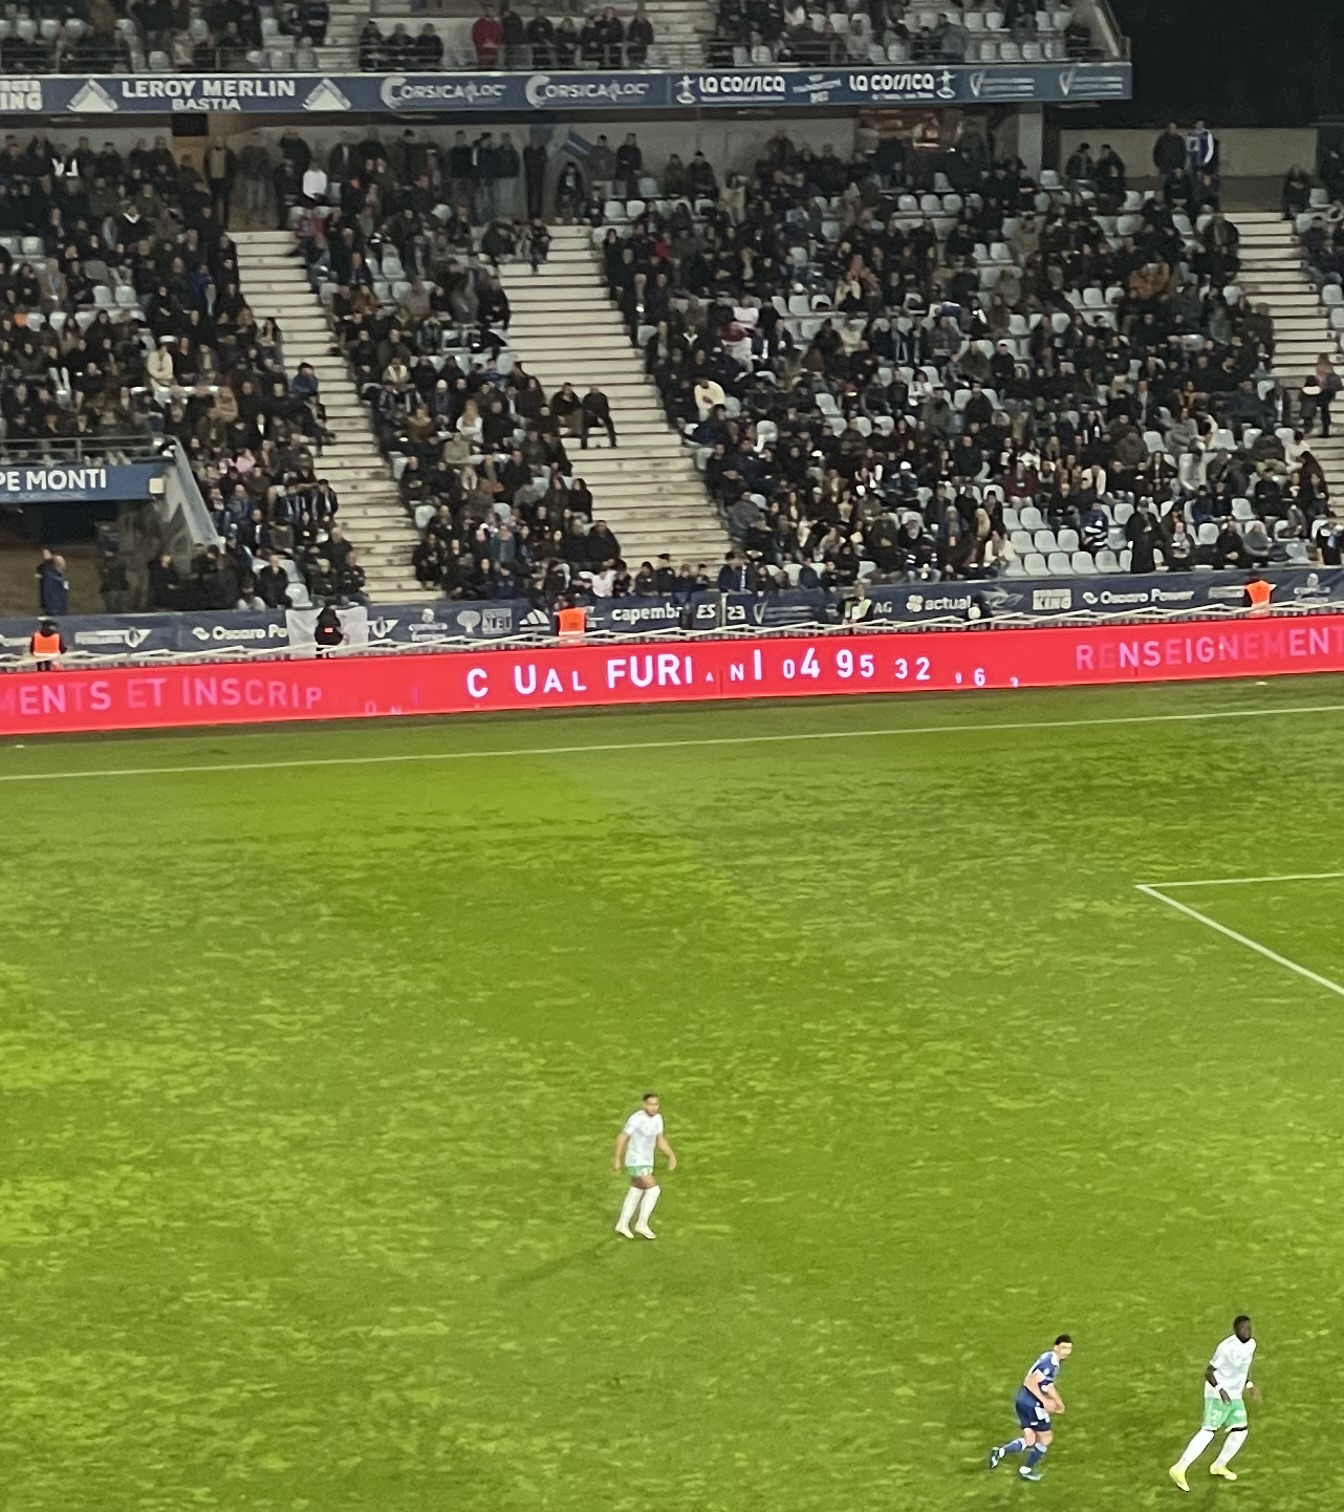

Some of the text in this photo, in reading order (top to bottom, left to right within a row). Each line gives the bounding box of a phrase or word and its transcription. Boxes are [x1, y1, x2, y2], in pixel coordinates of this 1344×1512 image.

[122, 79, 295, 98] LEROY MERLIN
[172, 98, 241, 111] BASTIA
[26, 469, 106, 491] MONTI
[924, 594, 972, 612] actual
[783, 647, 820, 679] 04
[836, 648, 874, 679] 95
[895, 656, 931, 681] 32
[127, 677, 167, 709] ET
